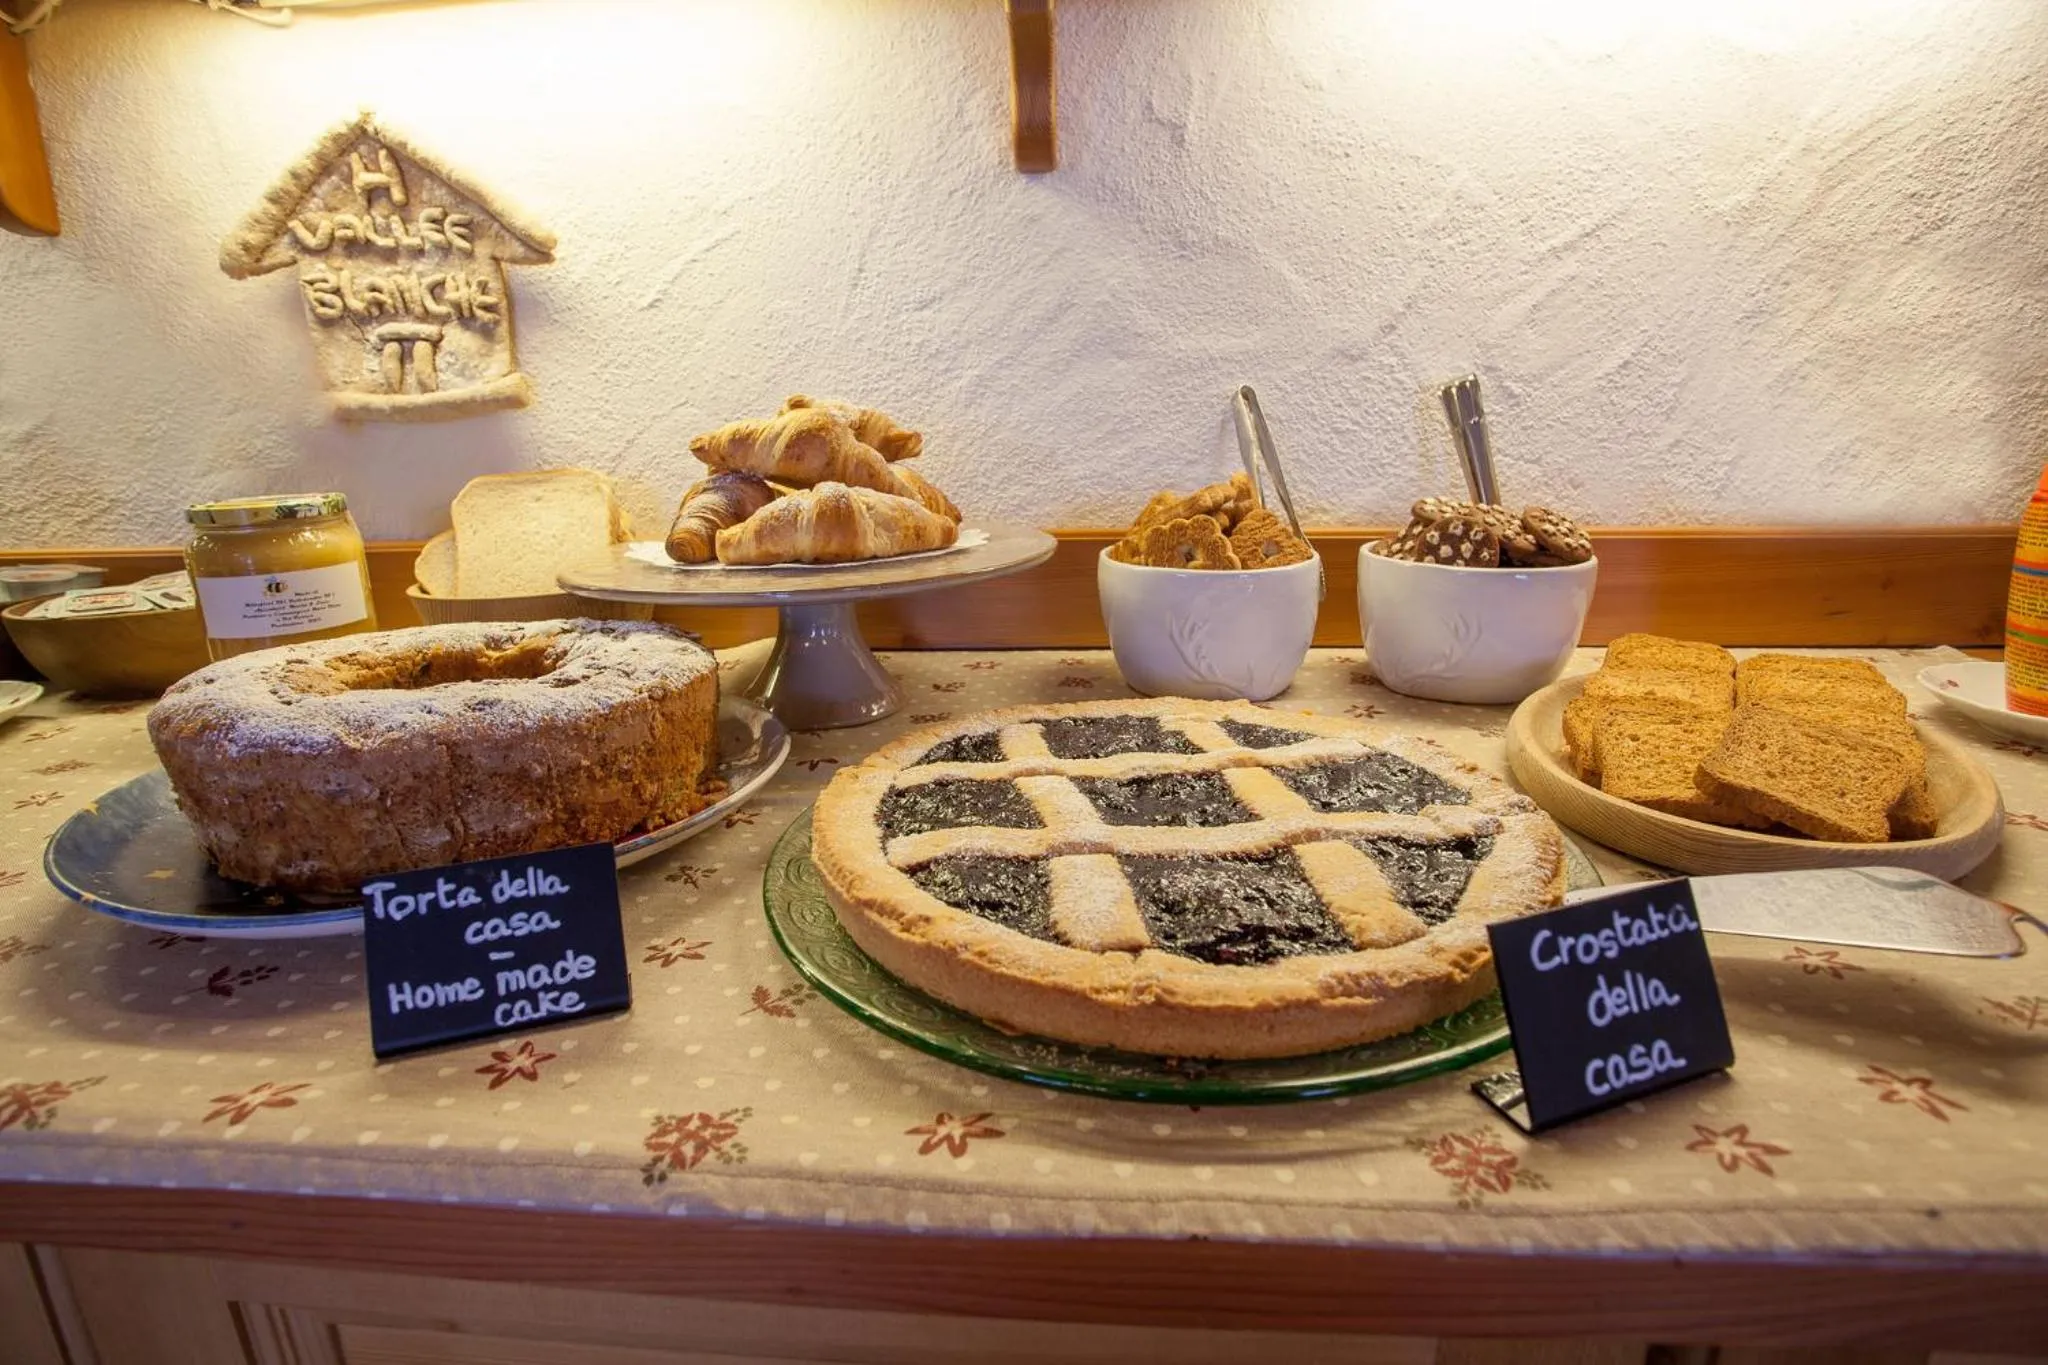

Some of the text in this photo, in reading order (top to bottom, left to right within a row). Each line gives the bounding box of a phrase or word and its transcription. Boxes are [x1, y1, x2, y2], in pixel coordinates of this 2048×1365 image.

[350, 148, 408, 208] H
[288, 206, 475, 254] VALLEE
[301, 269, 501, 325] BLANCHE
[361, 865, 570, 922] Torta della
[463, 910, 562, 945] casa
[1530, 903, 1699, 971] Crostata
[387, 948, 597, 1015] Home made
[1587, 969, 1681, 1028] della
[1584, 1038, 1688, 1096] casa
